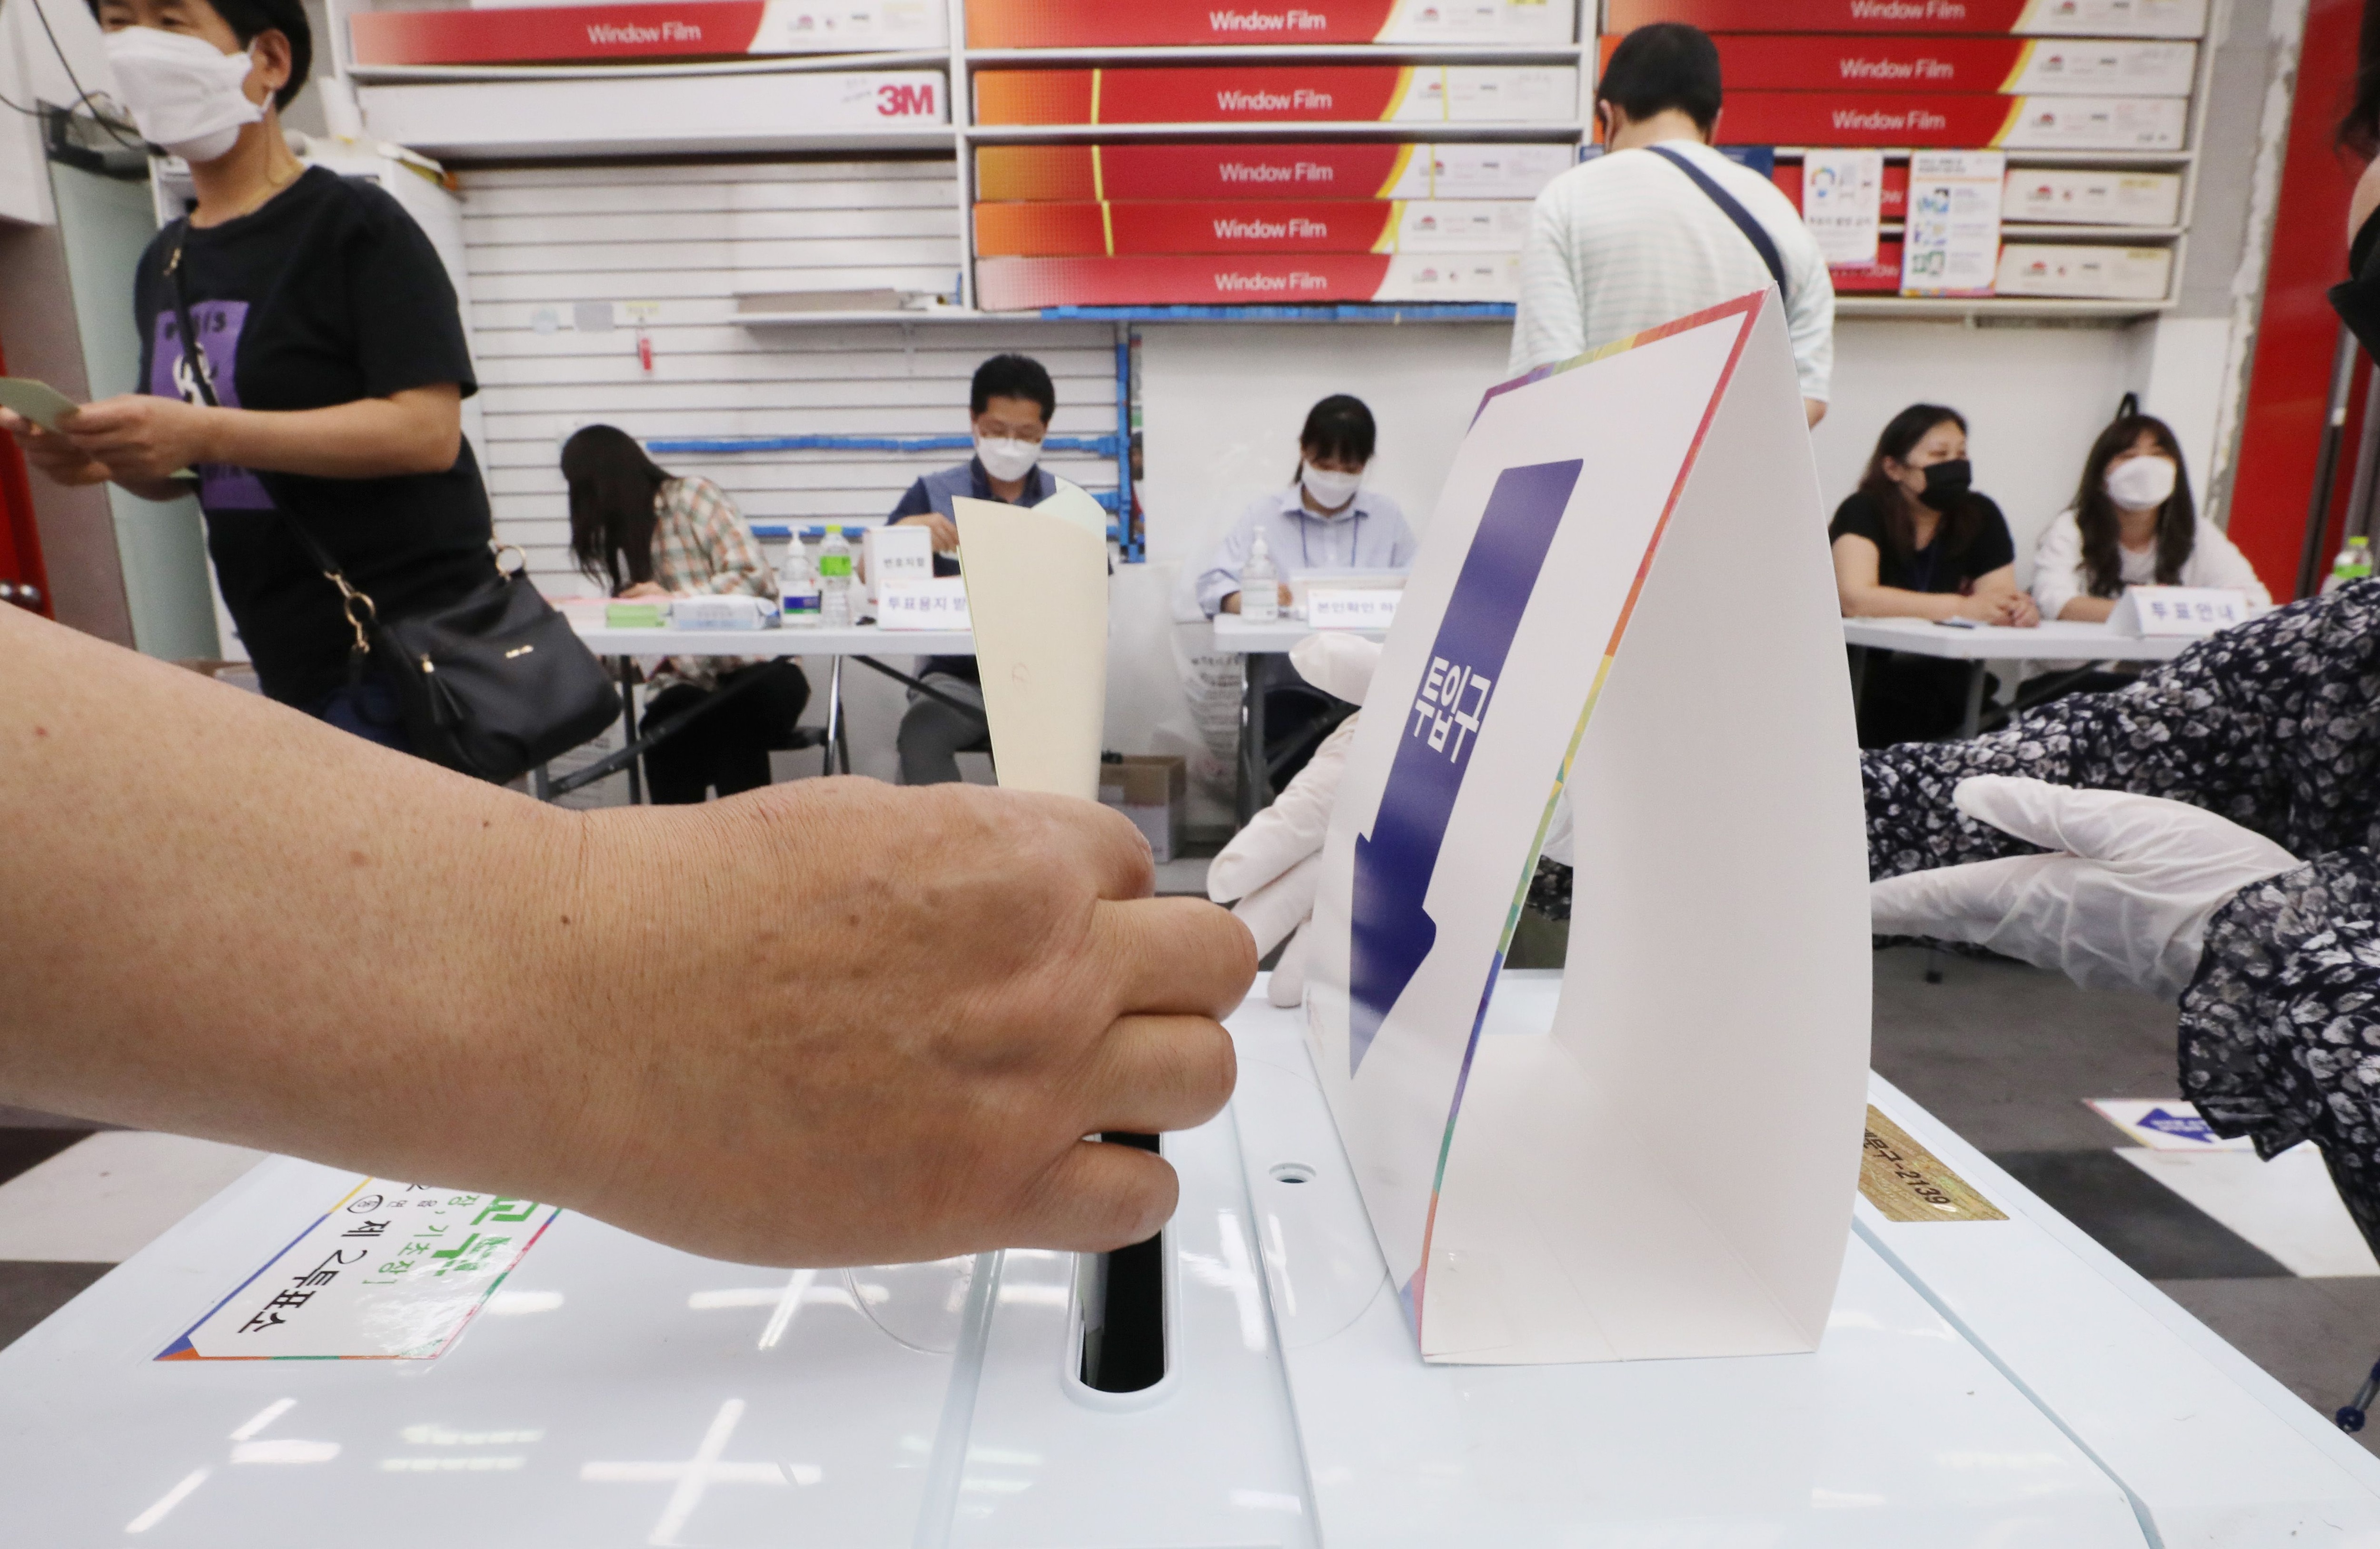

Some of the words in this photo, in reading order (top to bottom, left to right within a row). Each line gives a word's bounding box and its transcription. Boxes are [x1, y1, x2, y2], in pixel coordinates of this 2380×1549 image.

[1851, 0, 1924, 19] Window
[1926, 0, 1965, 19] Film
[1209, 10, 1285, 31] Window
[1287, 10, 1327, 30] Film
[586, 23, 660, 44] Window
[662, 21, 702, 41] Film
[1840, 58, 1913, 79] Window
[1914, 58, 1954, 78] Film
[877, 84, 934, 116] 3M
[1217, 90, 1291, 111] Window
[1293, 89, 1333, 109] Film
[1832, 110, 1905, 130] Window
[1906, 110, 1945, 129] Film
[1219, 163, 1292, 182] Window
[1295, 161, 1334, 181] Film
[1214, 219, 1286, 239] Window
[1288, 218, 1327, 237] Film
[1214, 273, 1287, 291] Window
[1289, 272, 1328, 290] Film
[889, 596, 947, 612] 투표용지
[953, 596, 967, 612] 받
[1317, 602, 1374, 614] 본인확인
[1380, 602, 1394, 612] 하
[2152, 602, 2234, 622] 투표안내
[1414, 656, 1491, 764] 투입구
